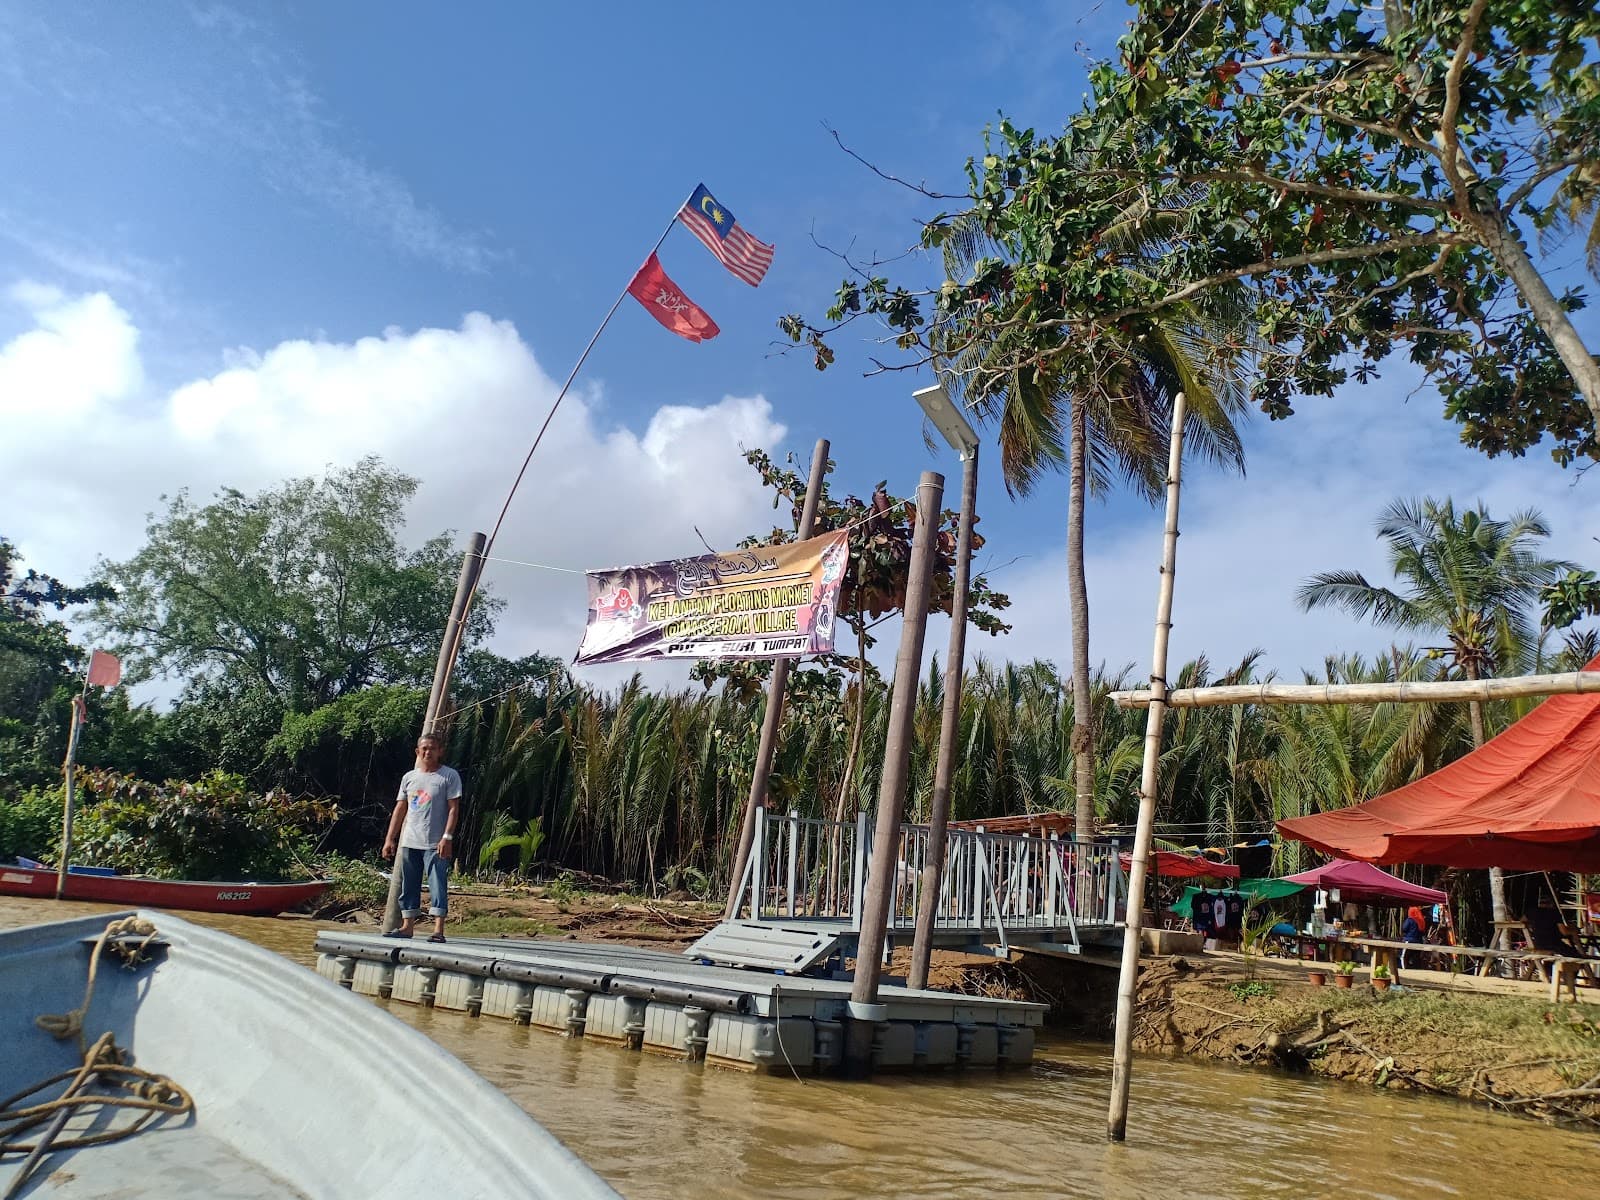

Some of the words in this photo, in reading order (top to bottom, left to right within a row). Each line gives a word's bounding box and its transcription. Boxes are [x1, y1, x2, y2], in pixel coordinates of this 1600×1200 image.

[648, 595, 713, 623] KELANTAN
[714, 588, 769, 614] FLOATING
[770, 582, 813, 608] MARKET
[763, 637, 808, 651] TUMPAT
